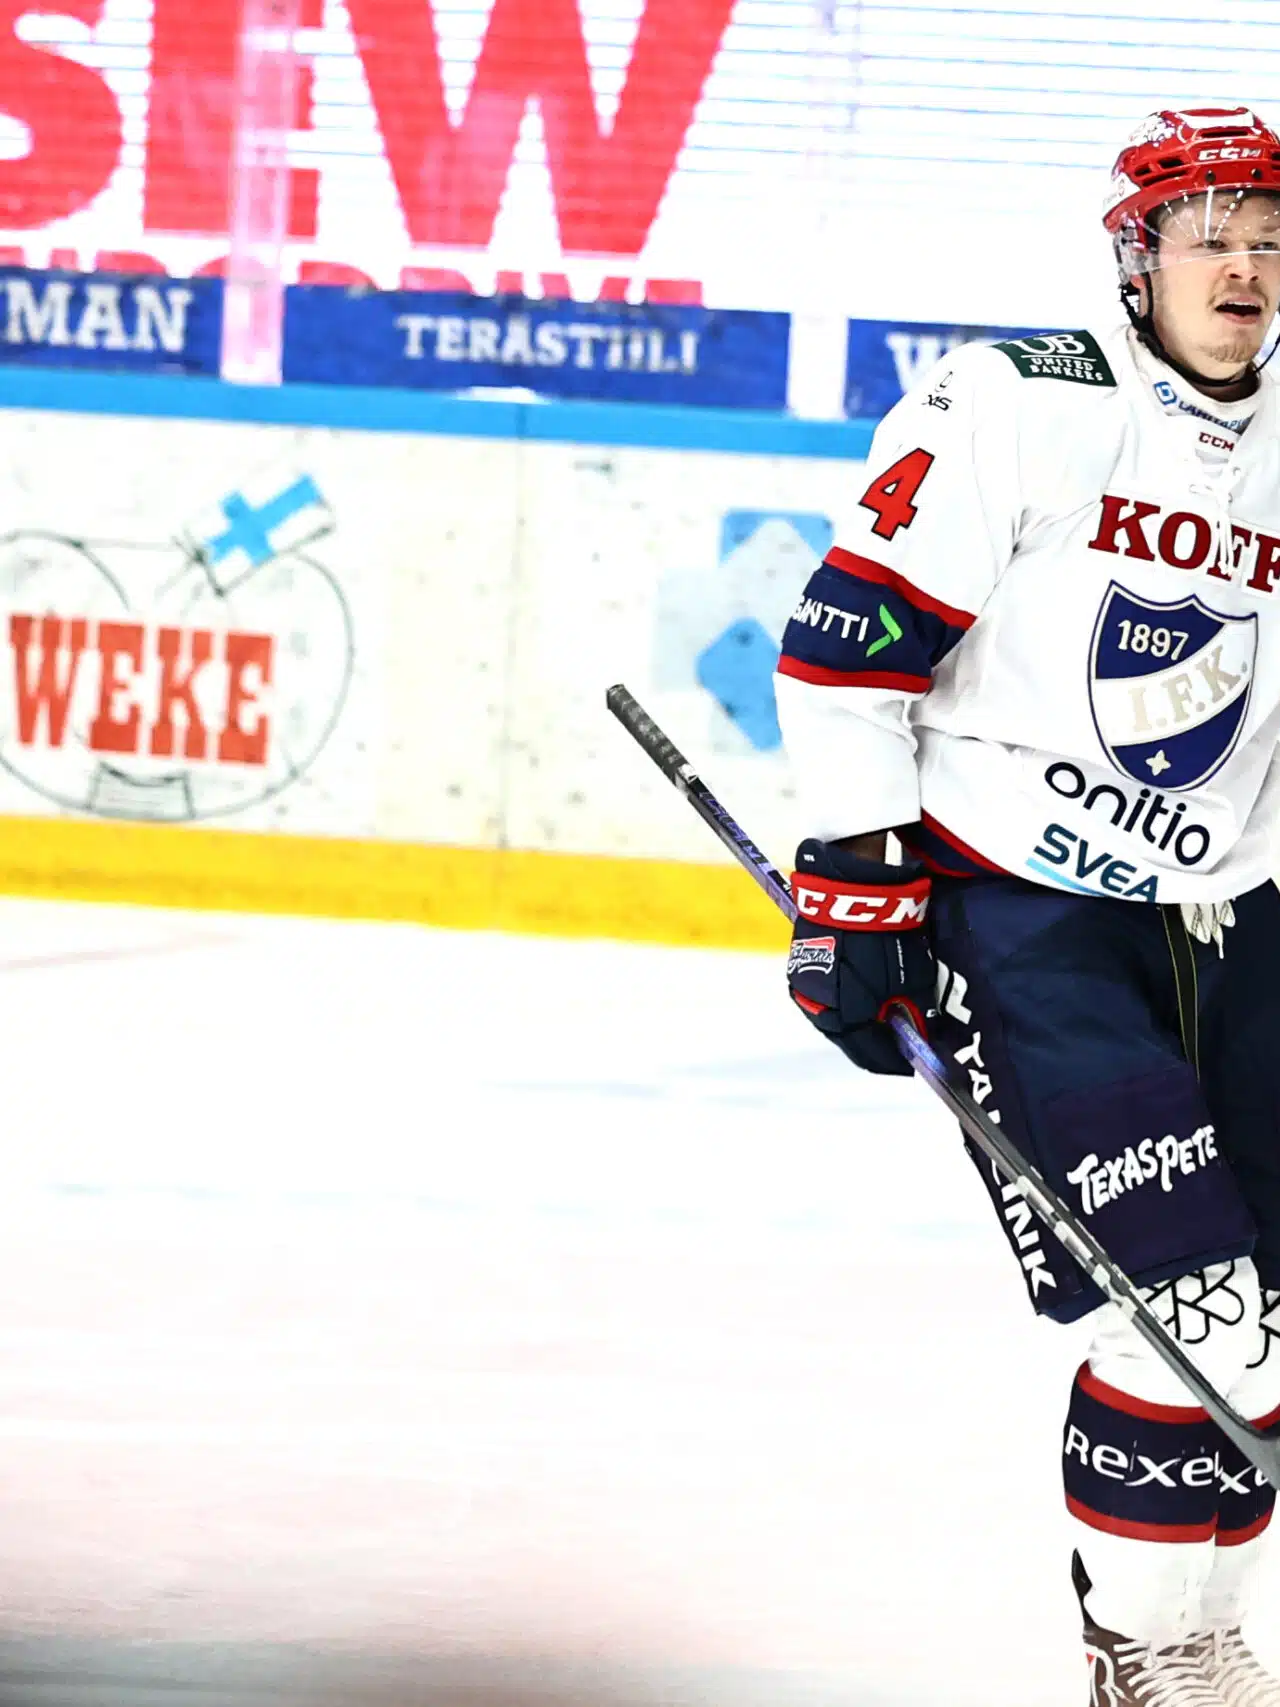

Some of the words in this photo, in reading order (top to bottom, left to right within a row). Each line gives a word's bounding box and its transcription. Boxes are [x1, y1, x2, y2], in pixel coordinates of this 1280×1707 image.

[1197, 146, 1262, 161] CCM
[1006, 333, 1086, 355] UB
[1031, 357, 1094, 371] UNITED
[1029, 364, 1104, 382] BANKERS
[1199, 431, 1235, 452] CCM
[858, 447, 935, 541] 4
[1117, 619, 1189, 661] 1897
[8, 613, 275, 767] WEKE
[1044, 761, 1211, 866] onitio
[1033, 823, 1159, 903] SVEA
[796, 886, 930, 924] CCM
[953, 1030, 1057, 1299] TAINK
